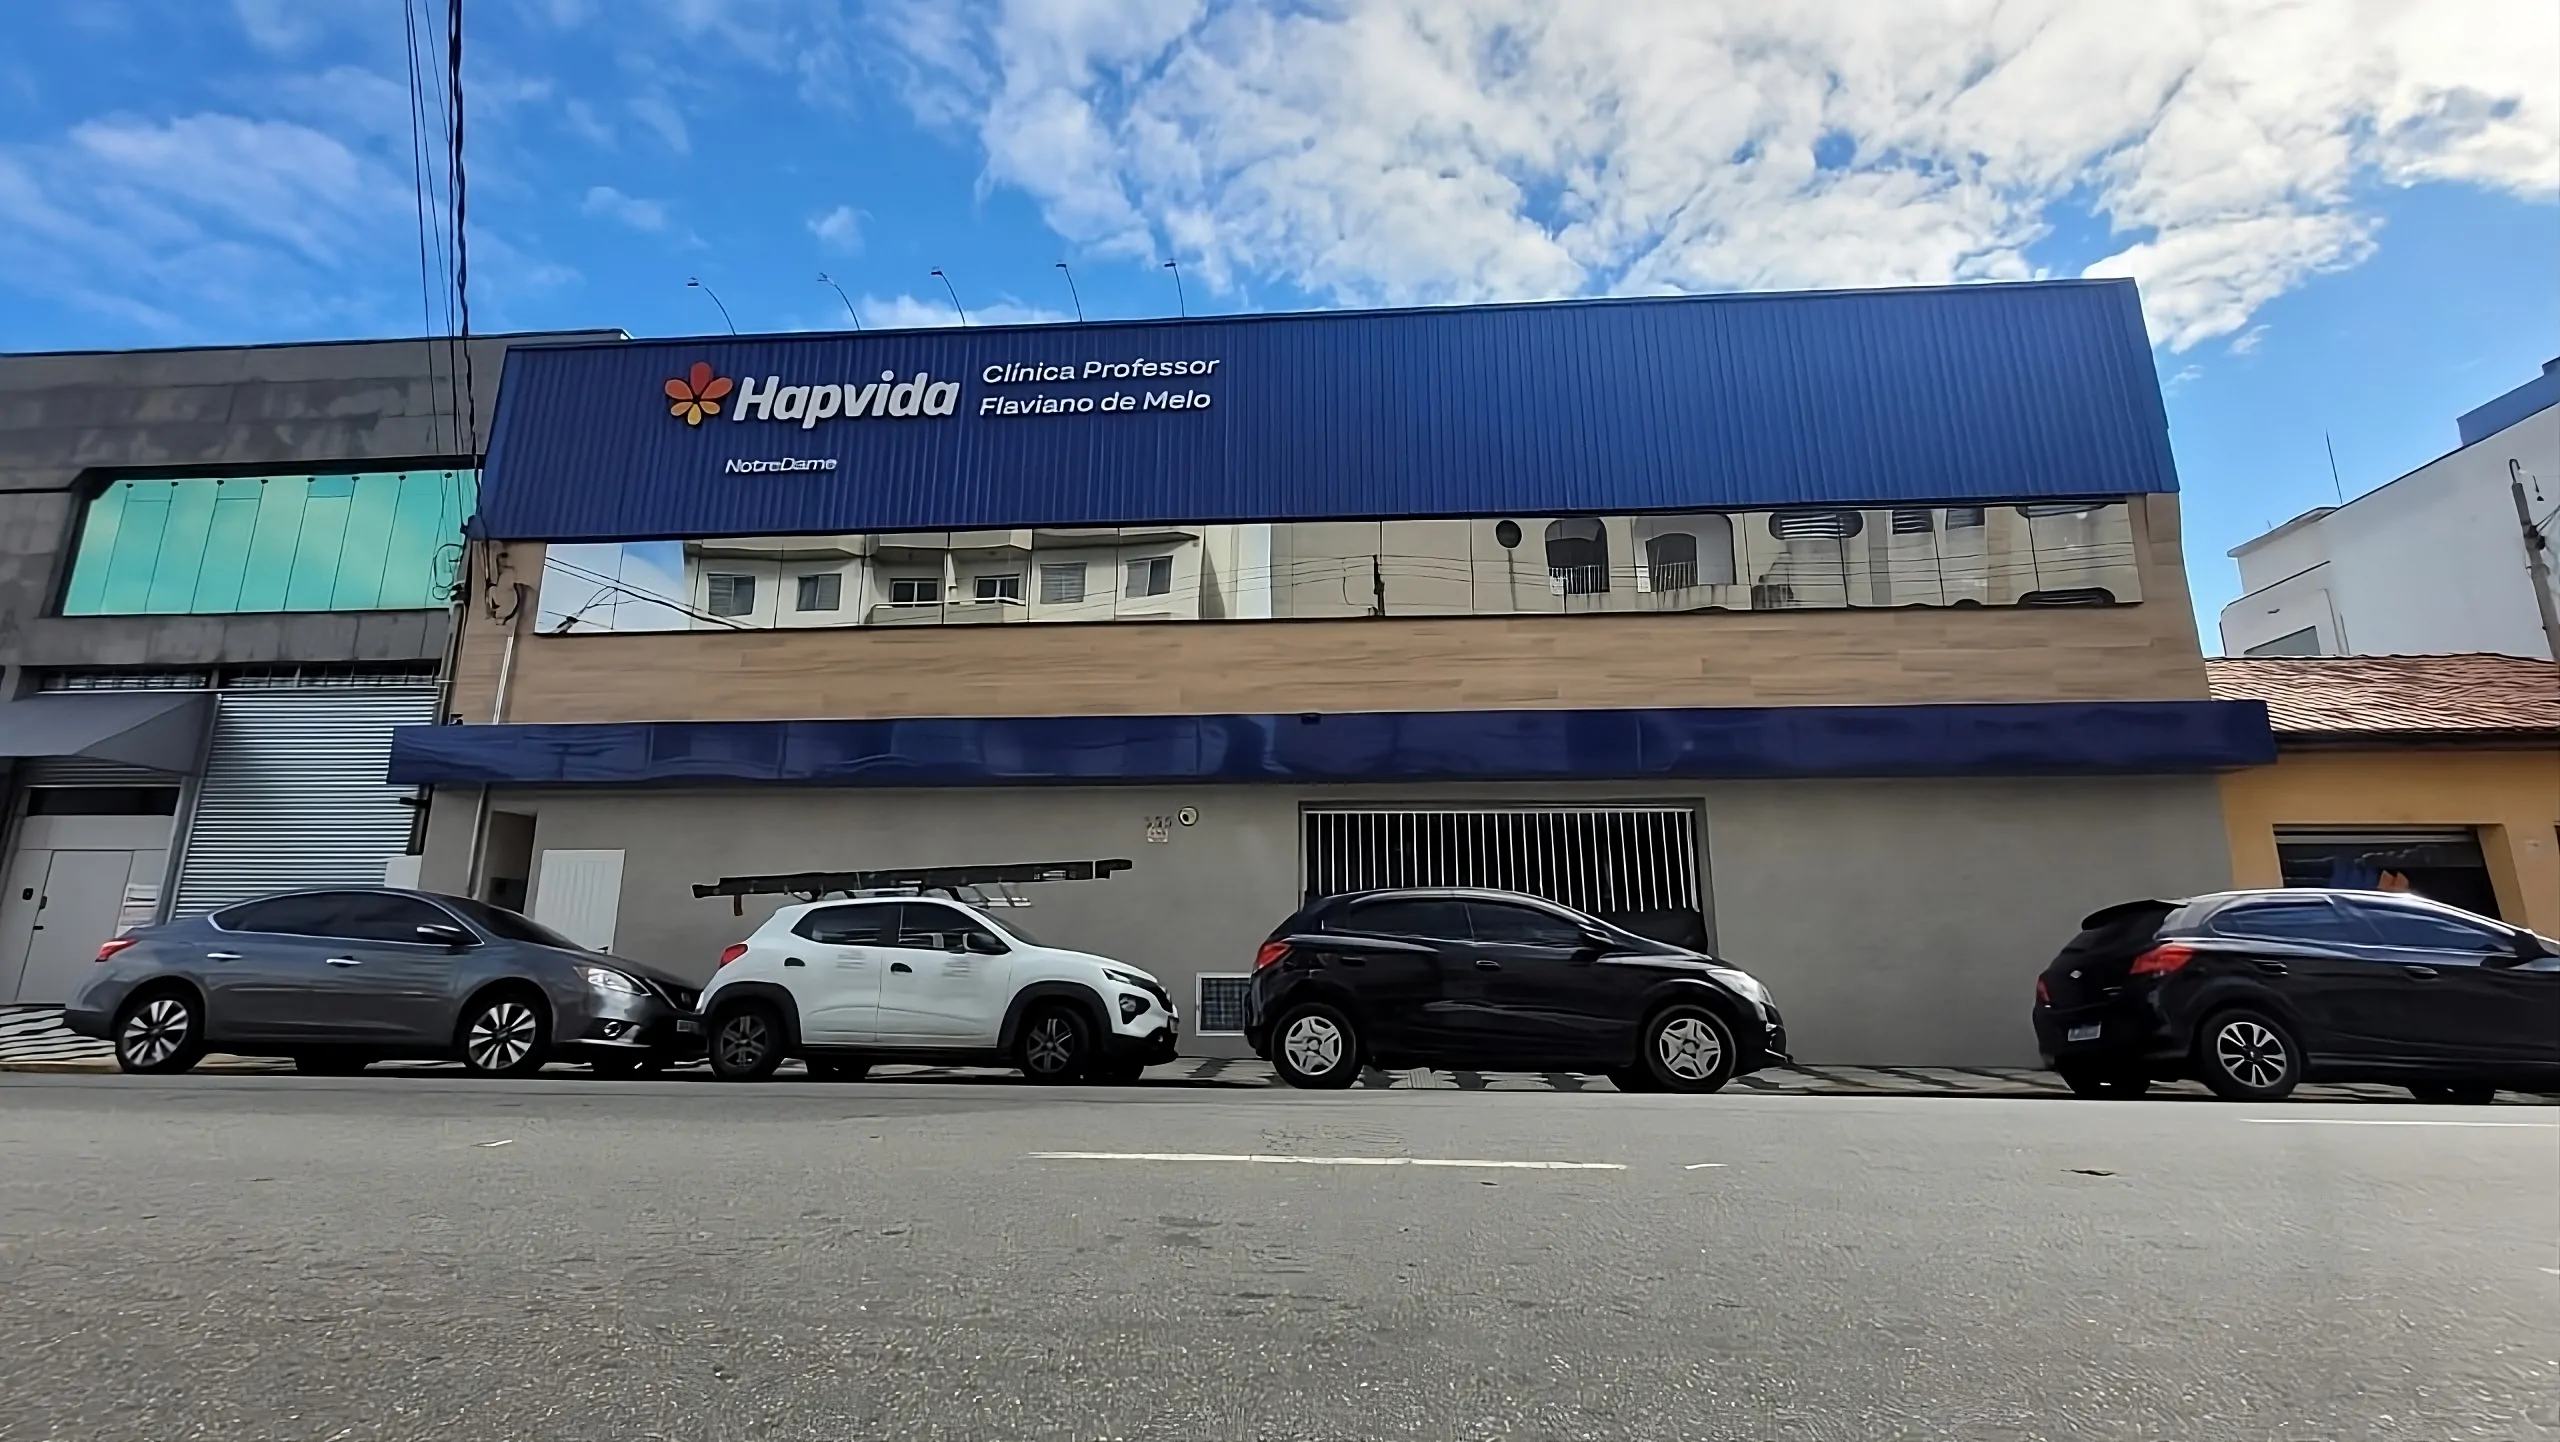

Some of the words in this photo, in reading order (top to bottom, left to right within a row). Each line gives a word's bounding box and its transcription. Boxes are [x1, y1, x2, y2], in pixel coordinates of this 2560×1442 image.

[982, 361, 1075, 384] Clínica
[1082, 357, 1220, 379] Professor
[732, 369, 960, 430] Hapvida
[979, 394, 1094, 416] Flaviano
[1100, 391, 1136, 412] de
[1142, 389, 1212, 411] Melo
[725, 457, 838, 474] NotreDame
